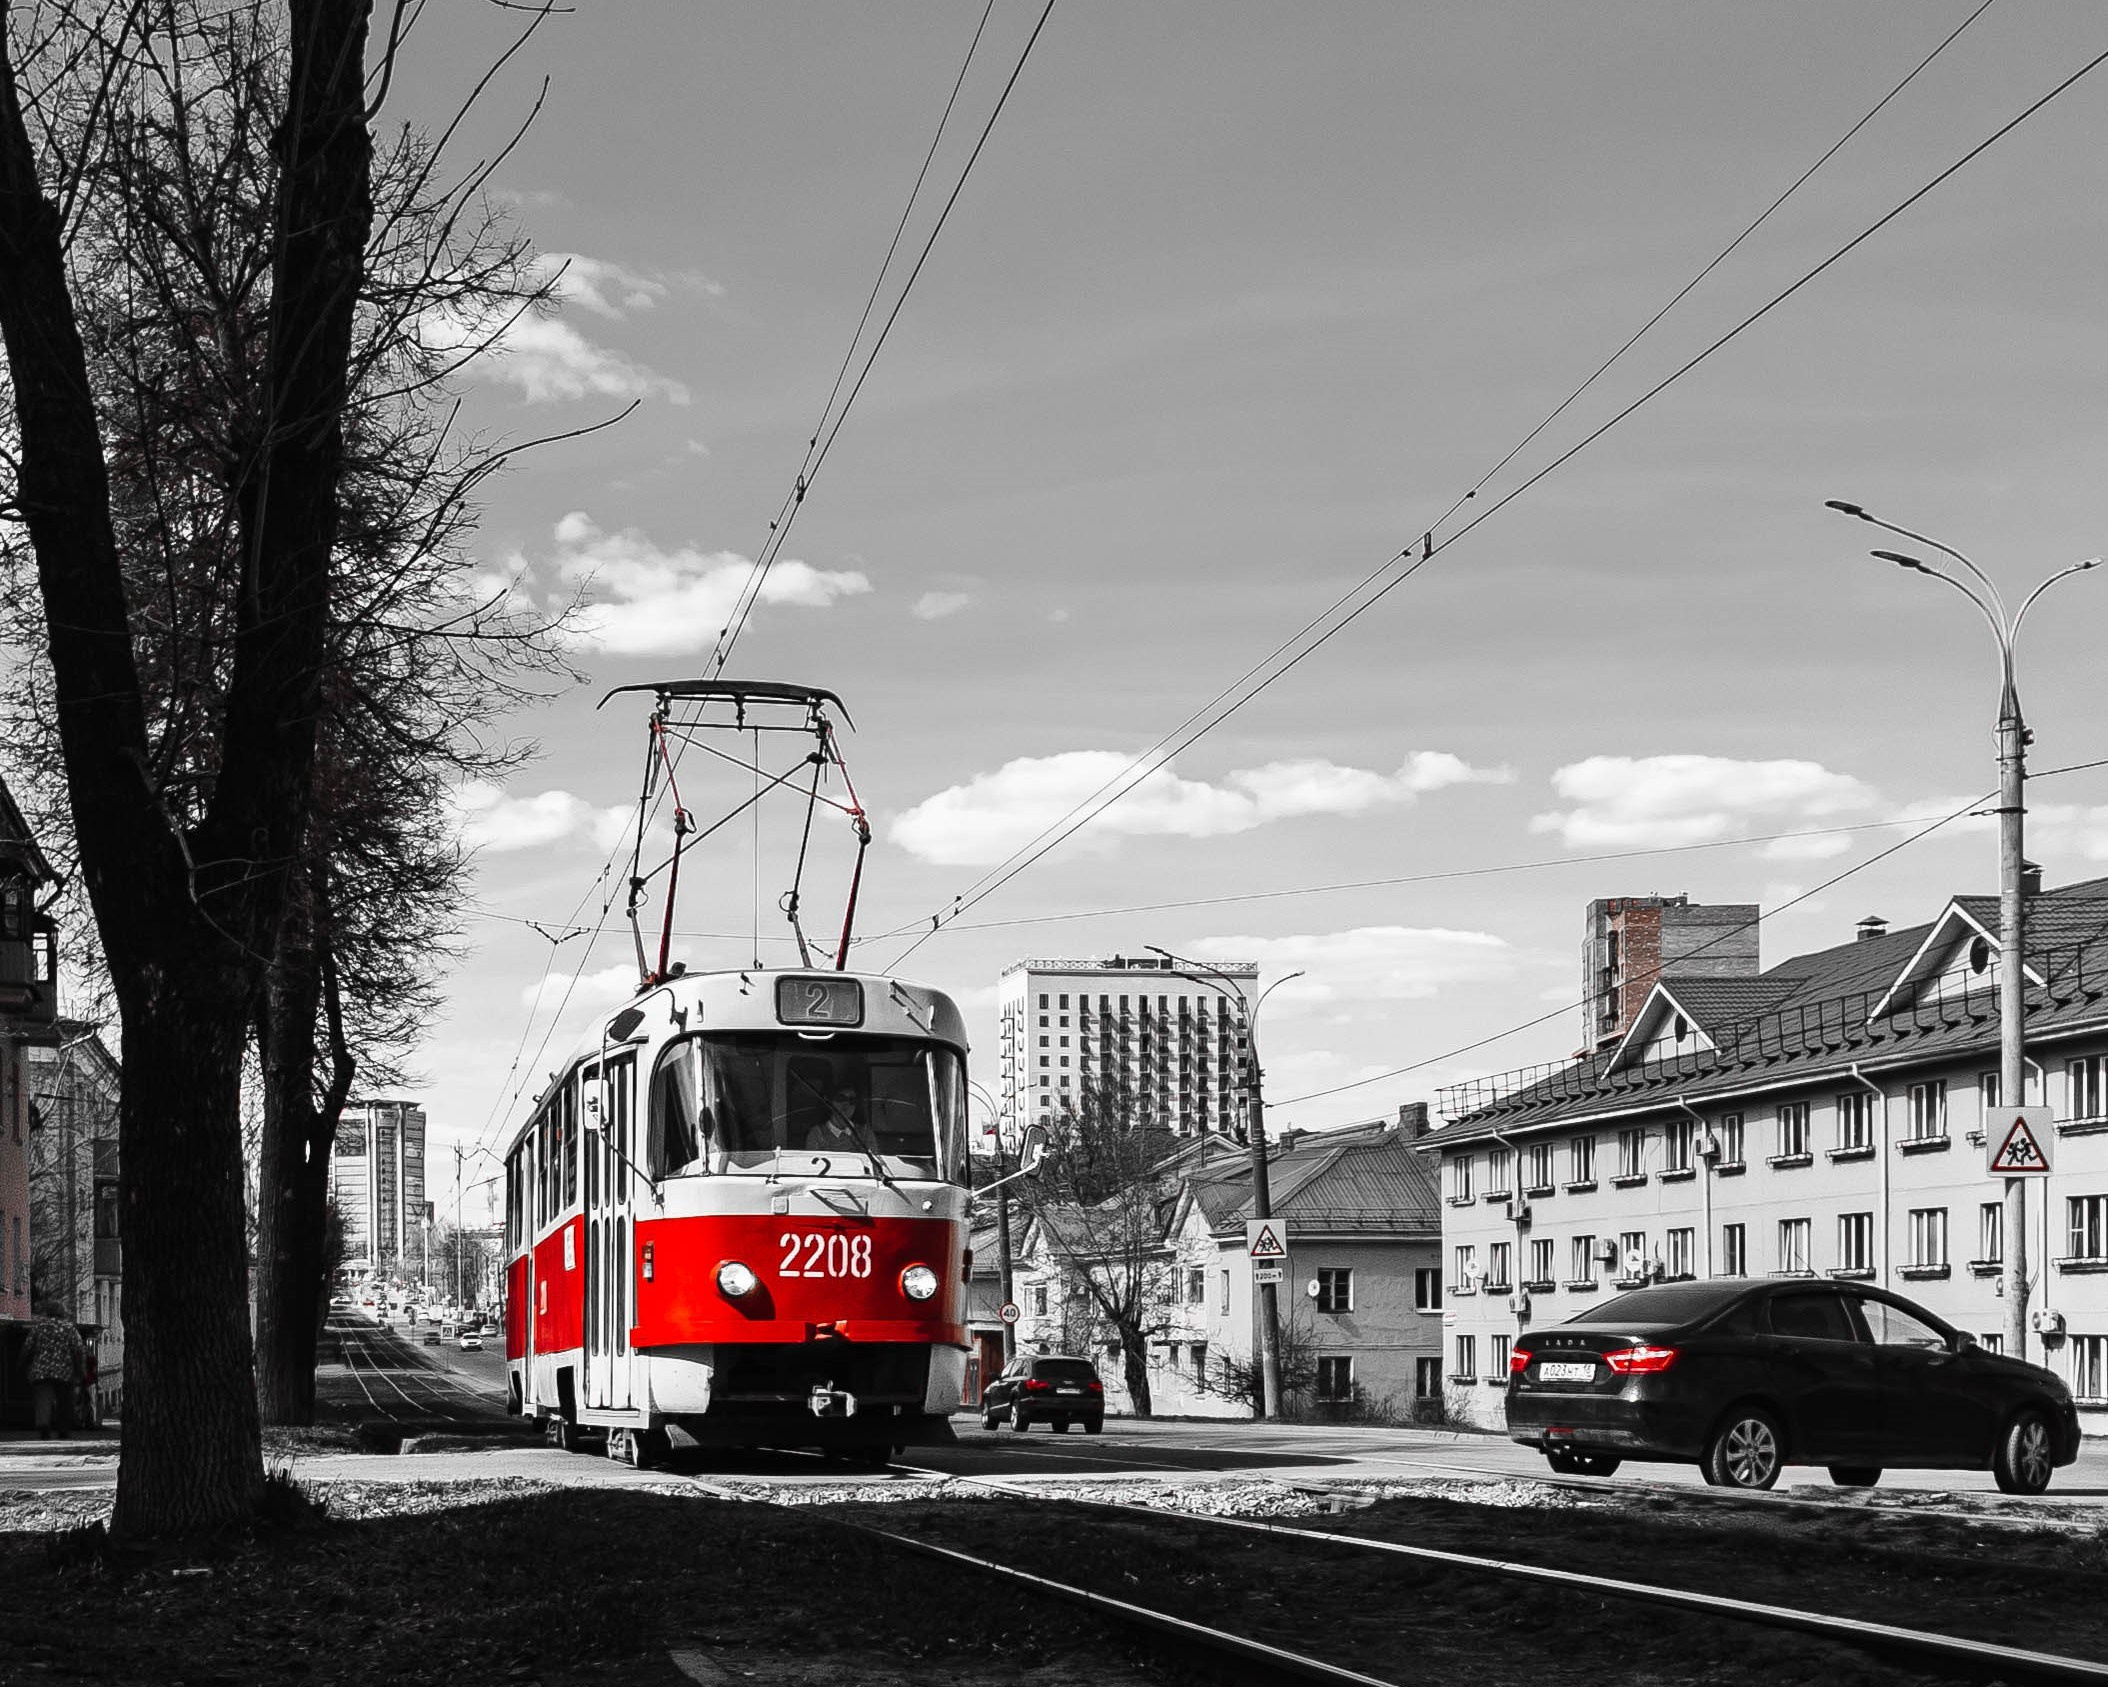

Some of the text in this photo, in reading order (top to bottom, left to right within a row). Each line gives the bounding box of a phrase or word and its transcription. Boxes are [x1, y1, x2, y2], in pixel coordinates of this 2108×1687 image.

[805, 981, 830, 1018] 2
[811, 1157, 831, 1176] 2
[779, 1233, 871, 1278] 2208
[1003, 1308, 1016, 1317] 40
